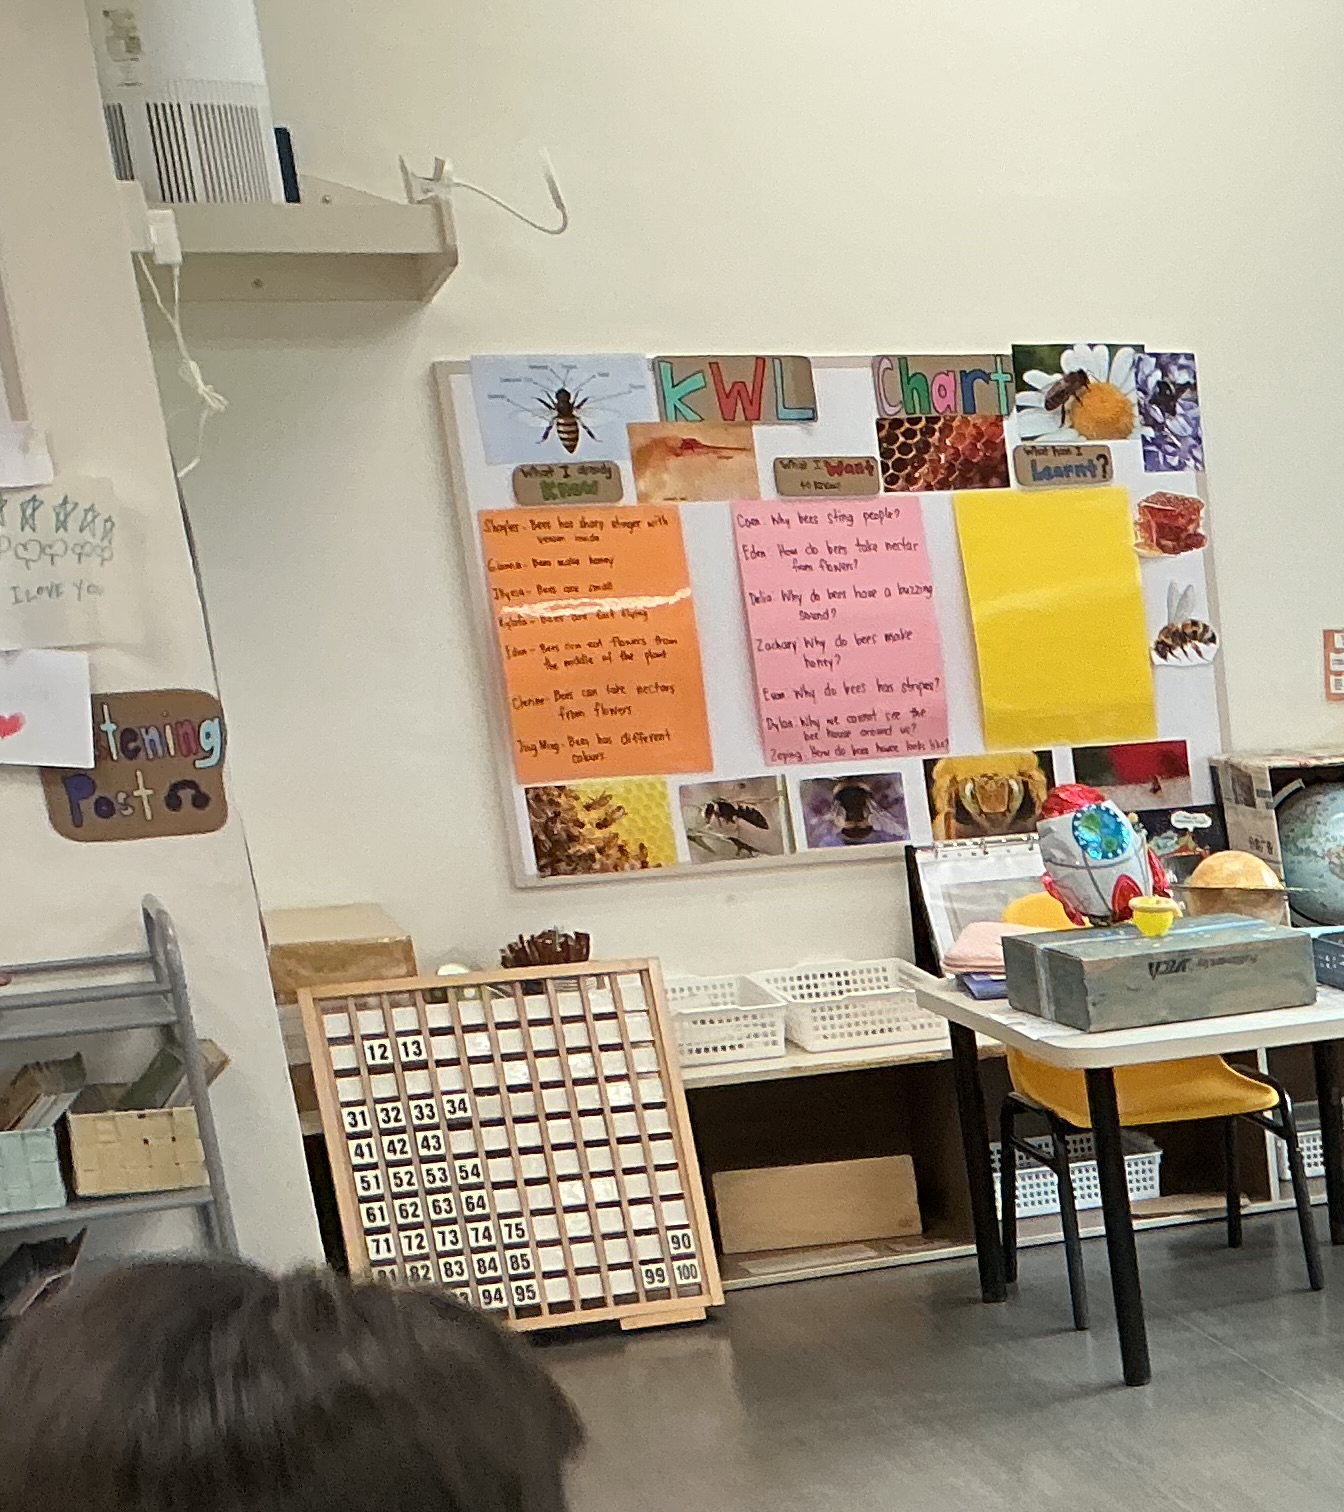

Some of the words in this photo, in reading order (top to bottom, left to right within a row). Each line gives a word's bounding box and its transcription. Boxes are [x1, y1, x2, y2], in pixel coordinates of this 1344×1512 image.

[658, 356, 815, 422] KWL
[876, 354, 1012, 416] Chart
[827, 508, 854, 526] sting
[25, 581, 64, 602] LOVE
[621, 728, 671, 746] different
[62, 768, 154, 829] Post
[367, 1043, 389, 1061] 12
[401, 1039, 423, 1058] 13
[346, 1109, 368, 1129] 31
[380, 1106, 402, 1124] 32
[413, 1102, 436, 1121] 33
[445, 1097, 468, 1115] 34
[354, 1141, 375, 1160] 41
[386, 1137, 409, 1156] 42
[420, 1133, 442, 1152] 43
[360, 1174, 381, 1191] 51
[392, 1170, 416, 1188] 52
[425, 1166, 449, 1185] 53
[458, 1163, 481, 1180] 54
[366, 1204, 387, 1223] 61
[399, 1200, 421, 1220] 62
[431, 1196, 453, 1216] 63
[464, 1192, 487, 1212] 64
[370, 1237, 392, 1256] 71
[403, 1233, 426, 1252] 72
[437, 1229, 459, 1247] 73
[470, 1226, 493, 1244] 74
[504, 1221, 526, 1240] 75
[409, 1264, 432, 1283] 82
[443, 1260, 465, 1278] 83
[476, 1256, 498, 1274] 84
[509, 1252, 531, 1271] 85
[670, 1232, 692, 1251] 90
[481, 1287, 504, 1306] 94
[514, 1283, 537, 1302] 95
[644, 1265, 666, 1285] 99
[676, 1261, 698, 1281] 100
